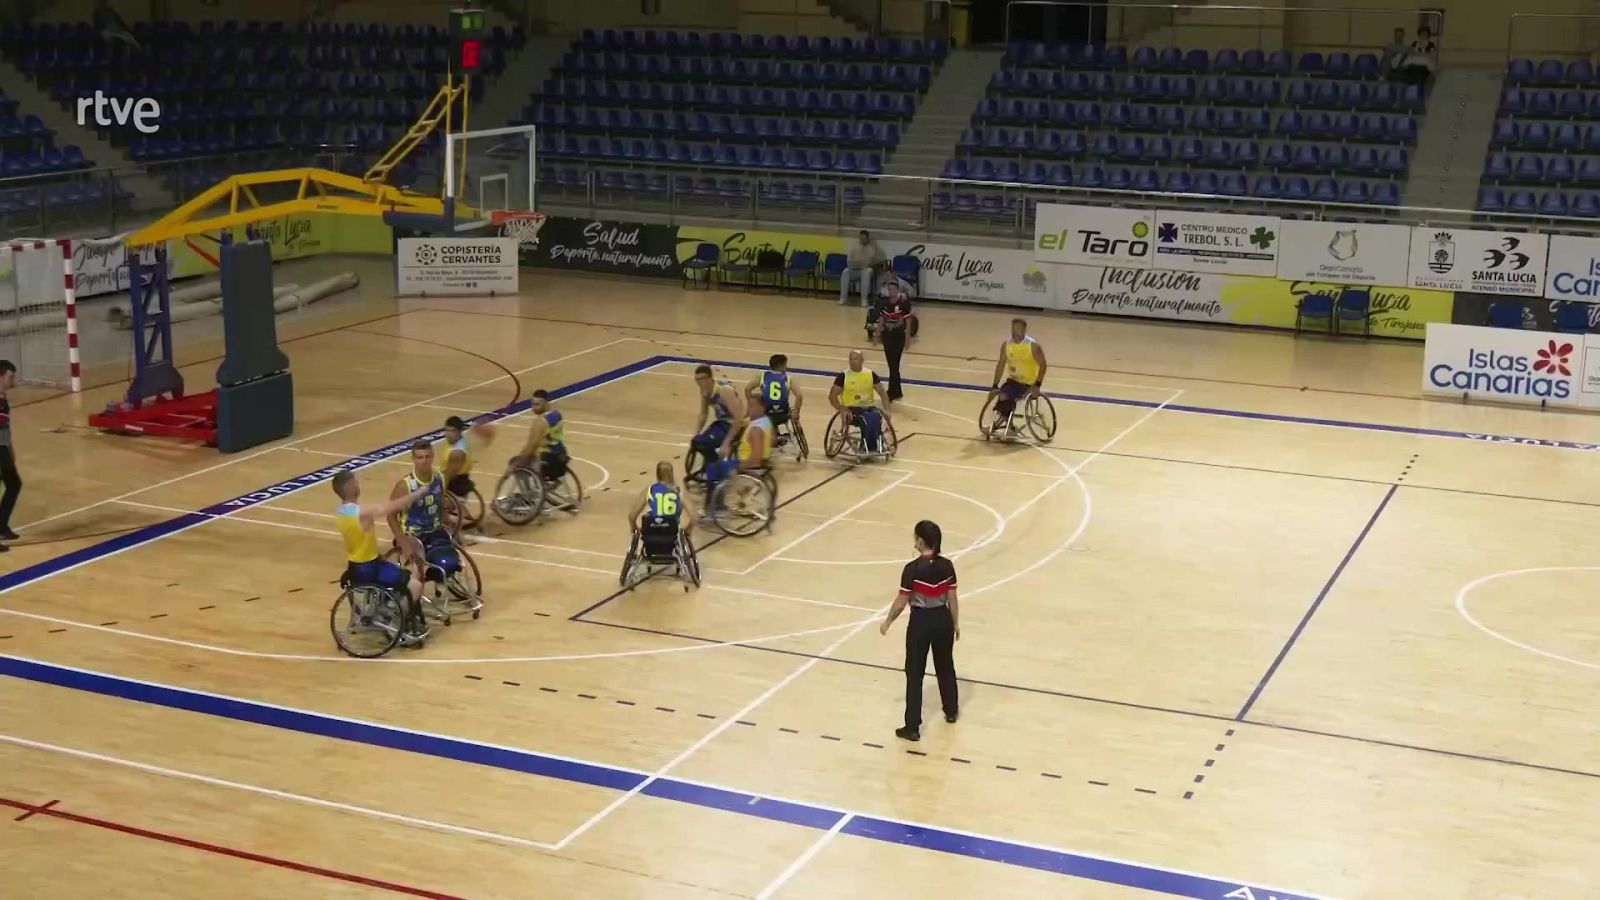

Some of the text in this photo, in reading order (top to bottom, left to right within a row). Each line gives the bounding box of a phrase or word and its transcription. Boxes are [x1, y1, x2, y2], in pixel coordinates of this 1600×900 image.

[583, 221, 639, 249] Salud
[1181, 223, 1248, 235] CENTRO MEDICO
[1038, 228, 1068, 251] el
[1077, 229, 1149, 257] Taro
[441, 255, 501, 264] CERVANTES
[1414, 280, 1437, 288] SANTA
[1471, 270, 1505, 281] SANTA
[1507, 272, 1537, 284] LUCIA
[1499, 286, 1536, 294] MUNICIPAL
[1468, 348, 1528, 373] Islas
[769, 381, 782, 401] 6
[1429, 364, 1570, 399] Canarias
[655, 492, 677, 516] 16
